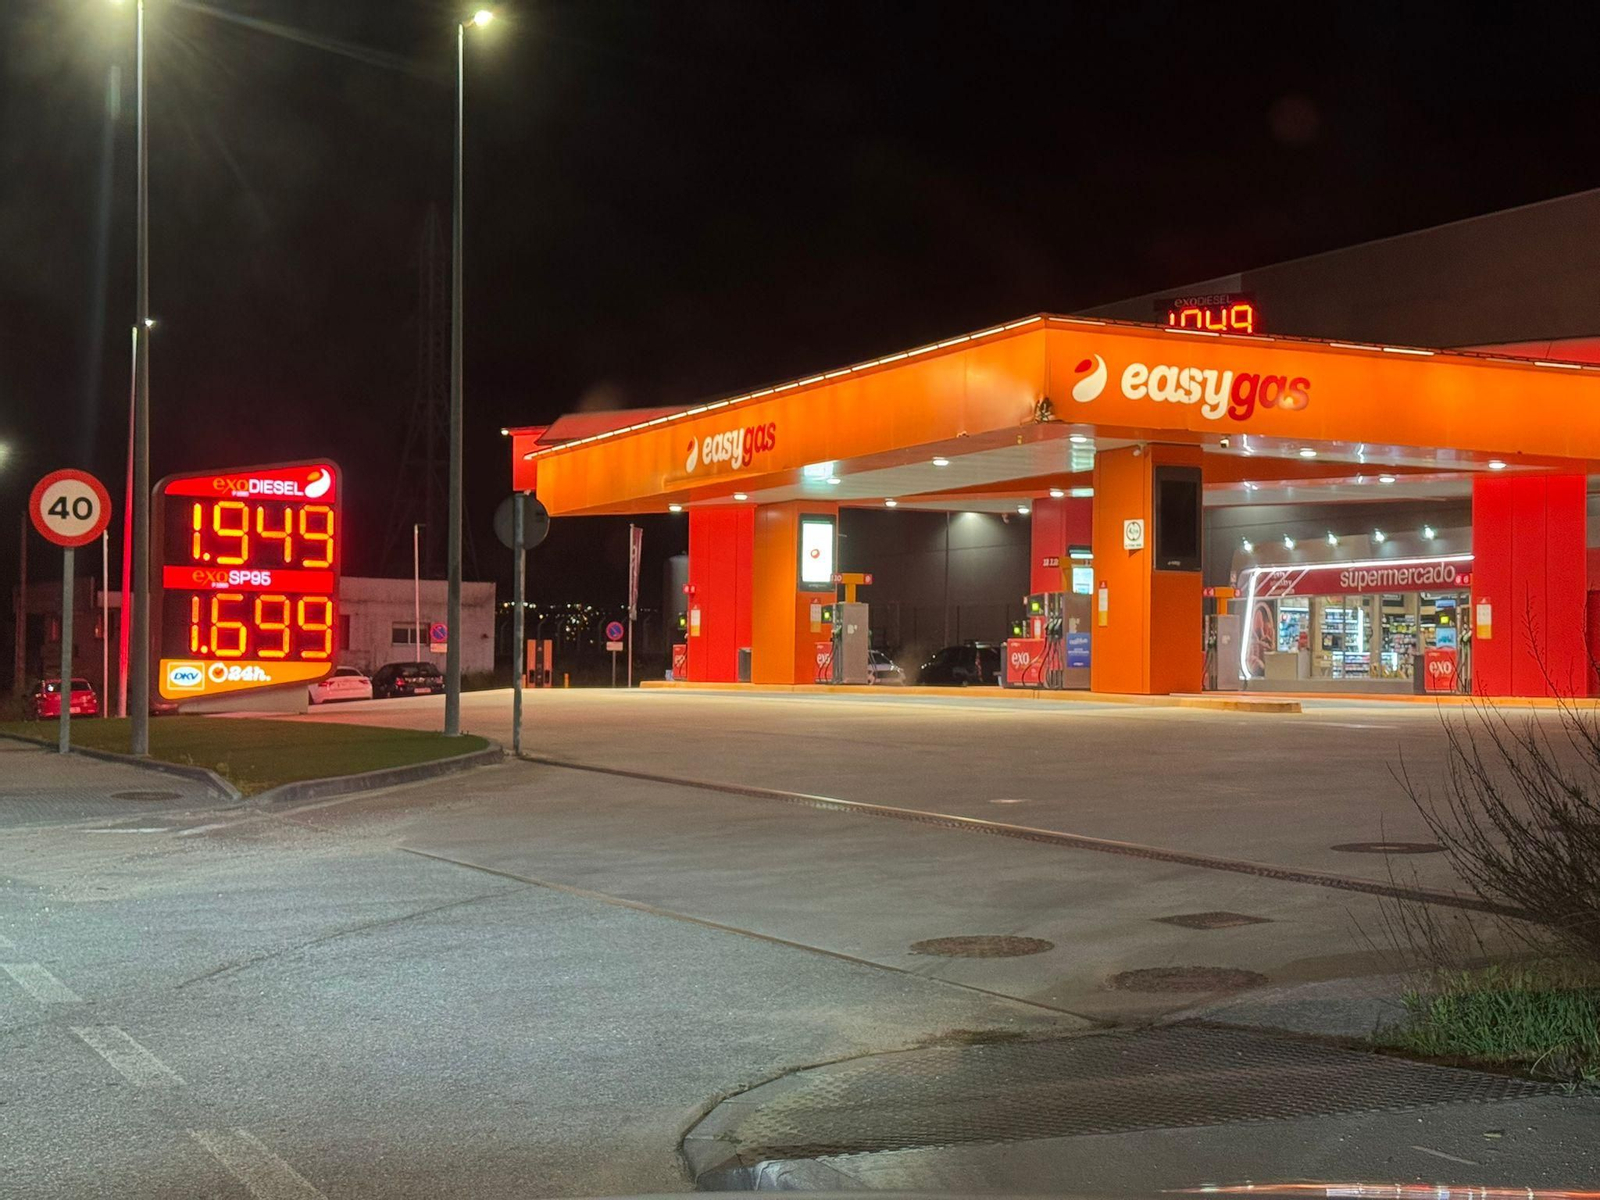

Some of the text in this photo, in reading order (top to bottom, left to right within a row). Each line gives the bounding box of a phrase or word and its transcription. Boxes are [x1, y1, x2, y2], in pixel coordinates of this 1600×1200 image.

[1121, 362, 1311, 421] easygas
[702, 422, 776, 467] easygas
[48, 496, 93, 521] 40
[193, 501, 334, 568] 1.949
[1340, 561, 1456, 592] supermercado
[191, 593, 333, 659] 1.699
[1011, 651, 1030, 669] exo
[1429, 660, 1453, 678] exo
[173, 672, 199, 681] DKV
